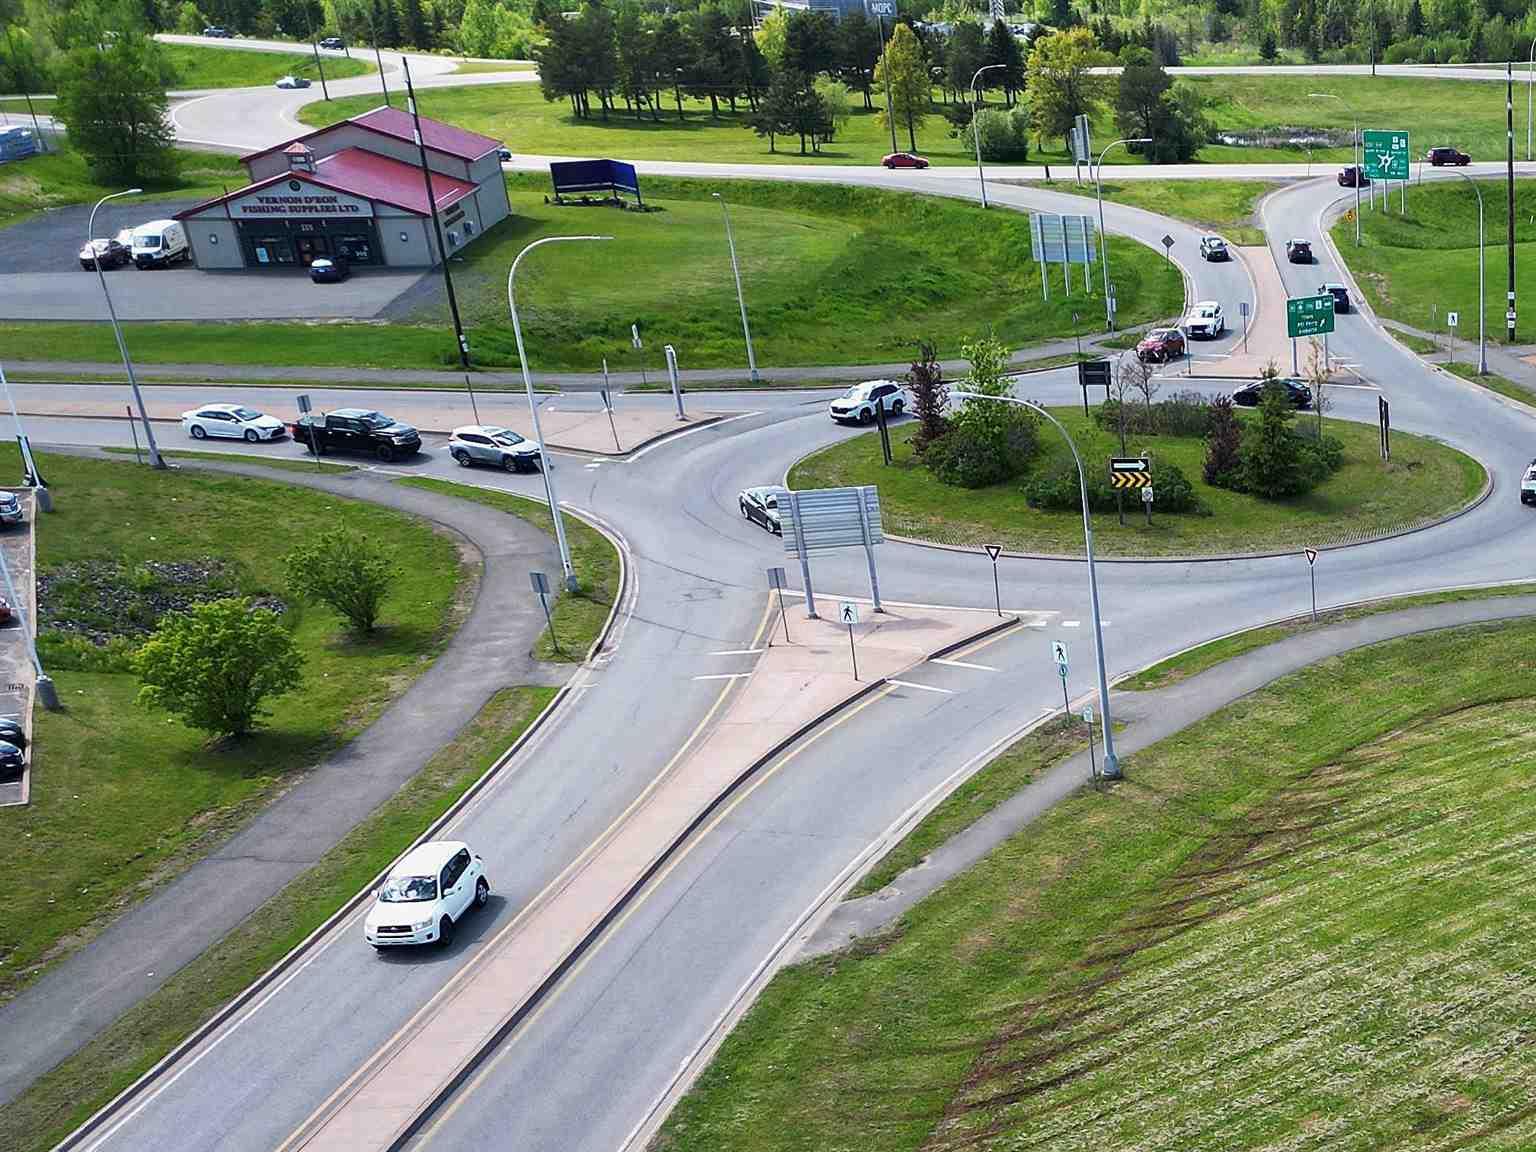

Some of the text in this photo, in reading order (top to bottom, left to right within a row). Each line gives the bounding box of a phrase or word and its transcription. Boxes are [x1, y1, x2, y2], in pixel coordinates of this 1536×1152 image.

[256, 196, 304, 204] VERNON
[241, 205, 286, 213] FISHING
[288, 204, 337, 213] SUPPLIES
